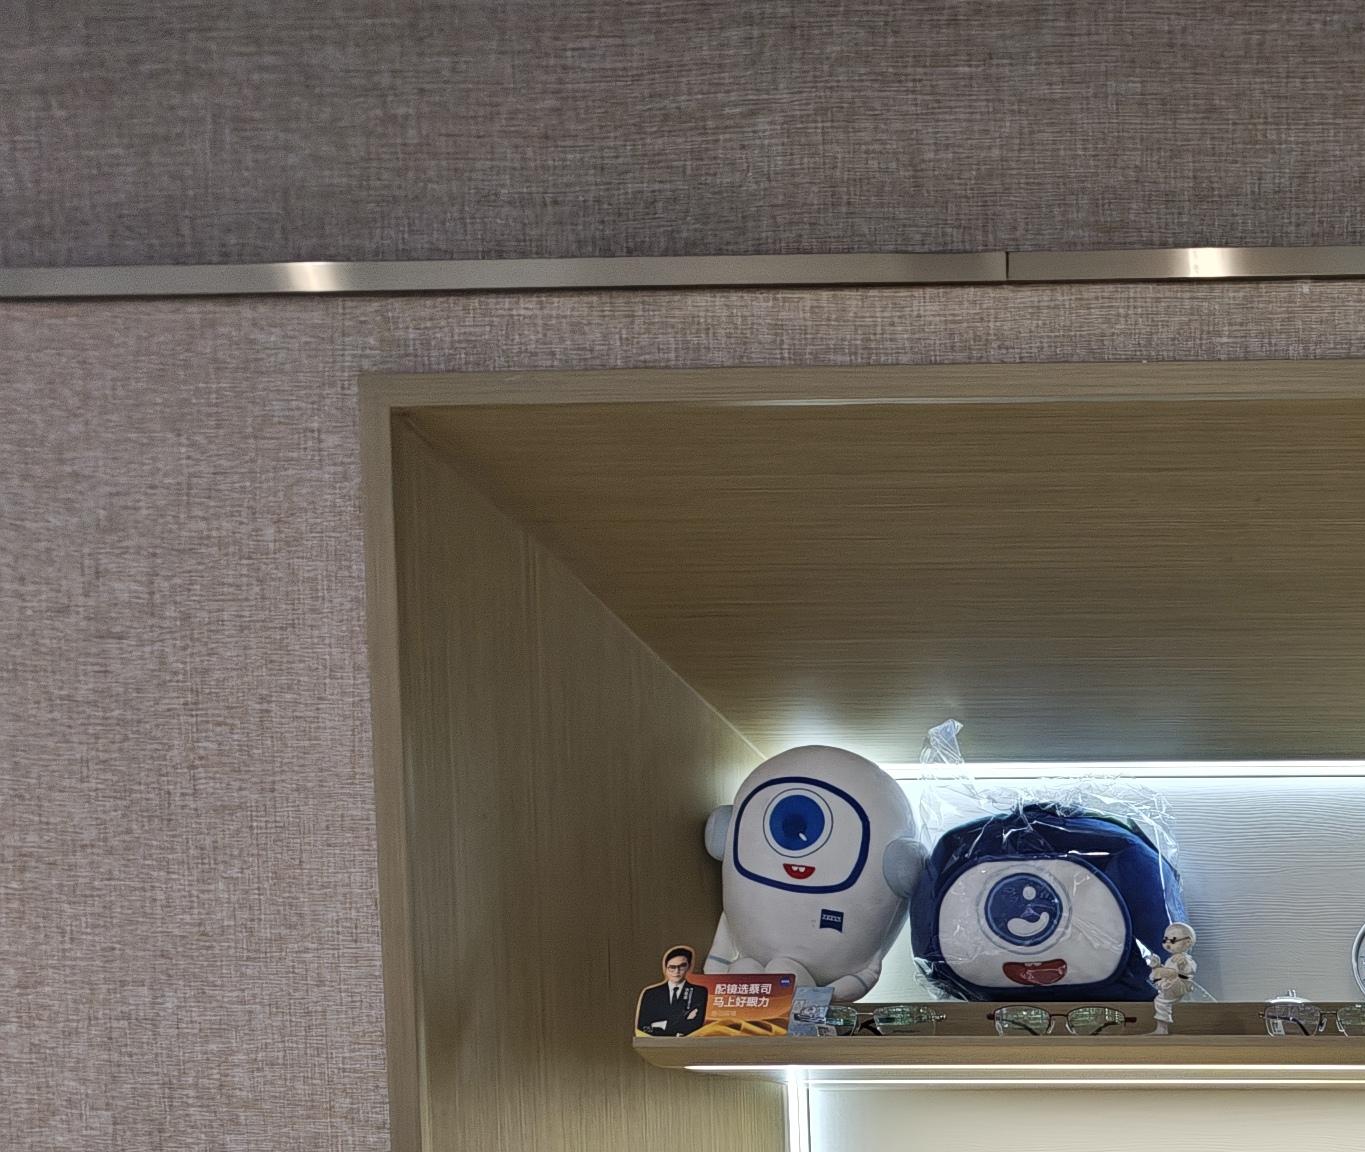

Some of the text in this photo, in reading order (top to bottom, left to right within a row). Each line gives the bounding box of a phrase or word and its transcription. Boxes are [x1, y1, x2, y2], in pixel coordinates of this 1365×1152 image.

[714, 983, 772, 995] 配镜选蔡司
[713, 996, 769, 1008] 马上好眼力
